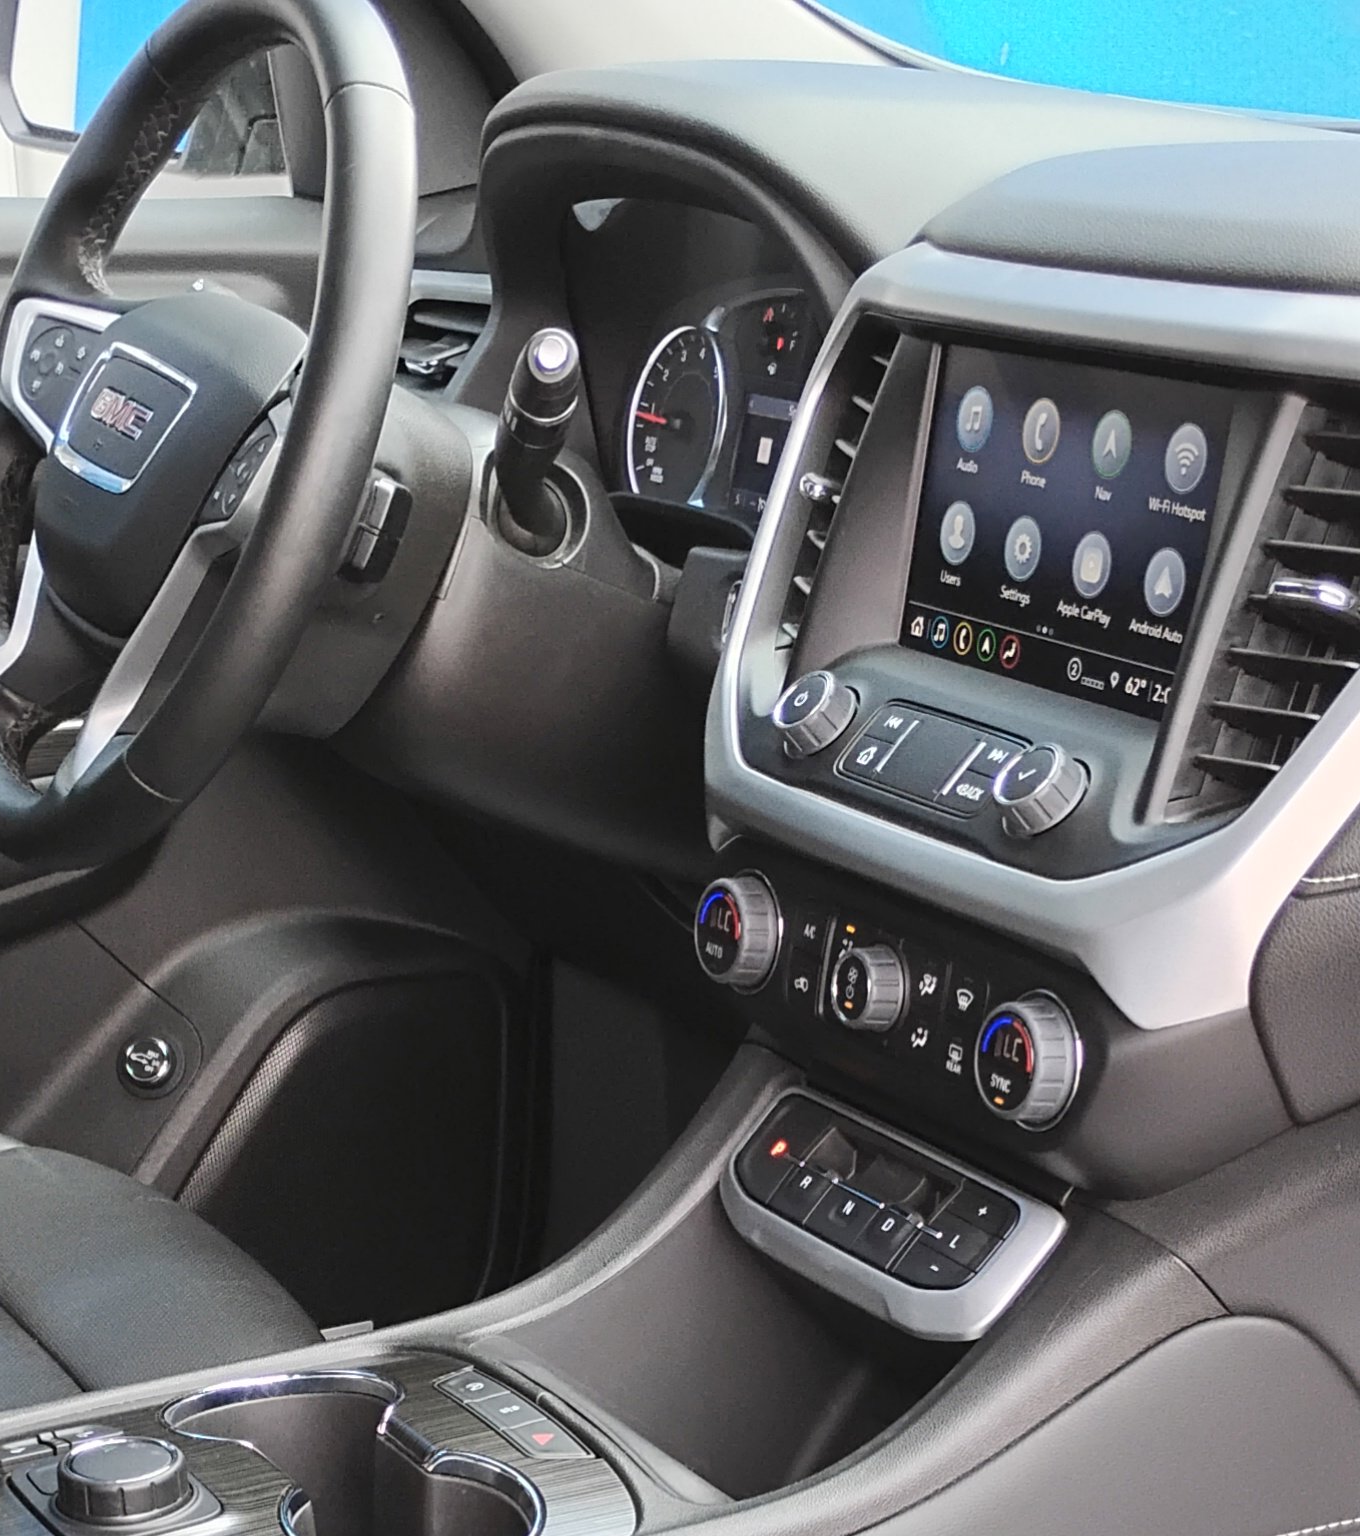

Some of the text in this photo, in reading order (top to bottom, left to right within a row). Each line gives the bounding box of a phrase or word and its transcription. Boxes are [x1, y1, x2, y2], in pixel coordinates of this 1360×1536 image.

[681, 350, 687, 362] 3
[700, 348, 706, 359] 4
[663, 369, 669, 381] 2
[91, 388, 154, 440] GMC
[957, 458, 978, 474] Audio
[1021, 471, 1046, 489] Phone
[1095, 486, 1111, 501] Nav
[1148, 497, 1207, 522] Wi-Fi Hotspot
[940, 569, 961, 587] Users
[1000, 585, 1030, 607] Settings
[1057, 600, 1111, 628] Apple CarPlay
[1128, 618, 1183, 645] Android Auto
[706, 941, 723, 958] AUTO
[946, 1060, 961, 1074] REAR
[990, 1073, 1011, 1093] SYNC
[770, 1139, 788, 1158] P
[799, 1176, 812, 1189] R
[842, 1200, 856, 1215] N
[881, 1218, 895, 1232] D
[949, 1234, 961, 1249] L
